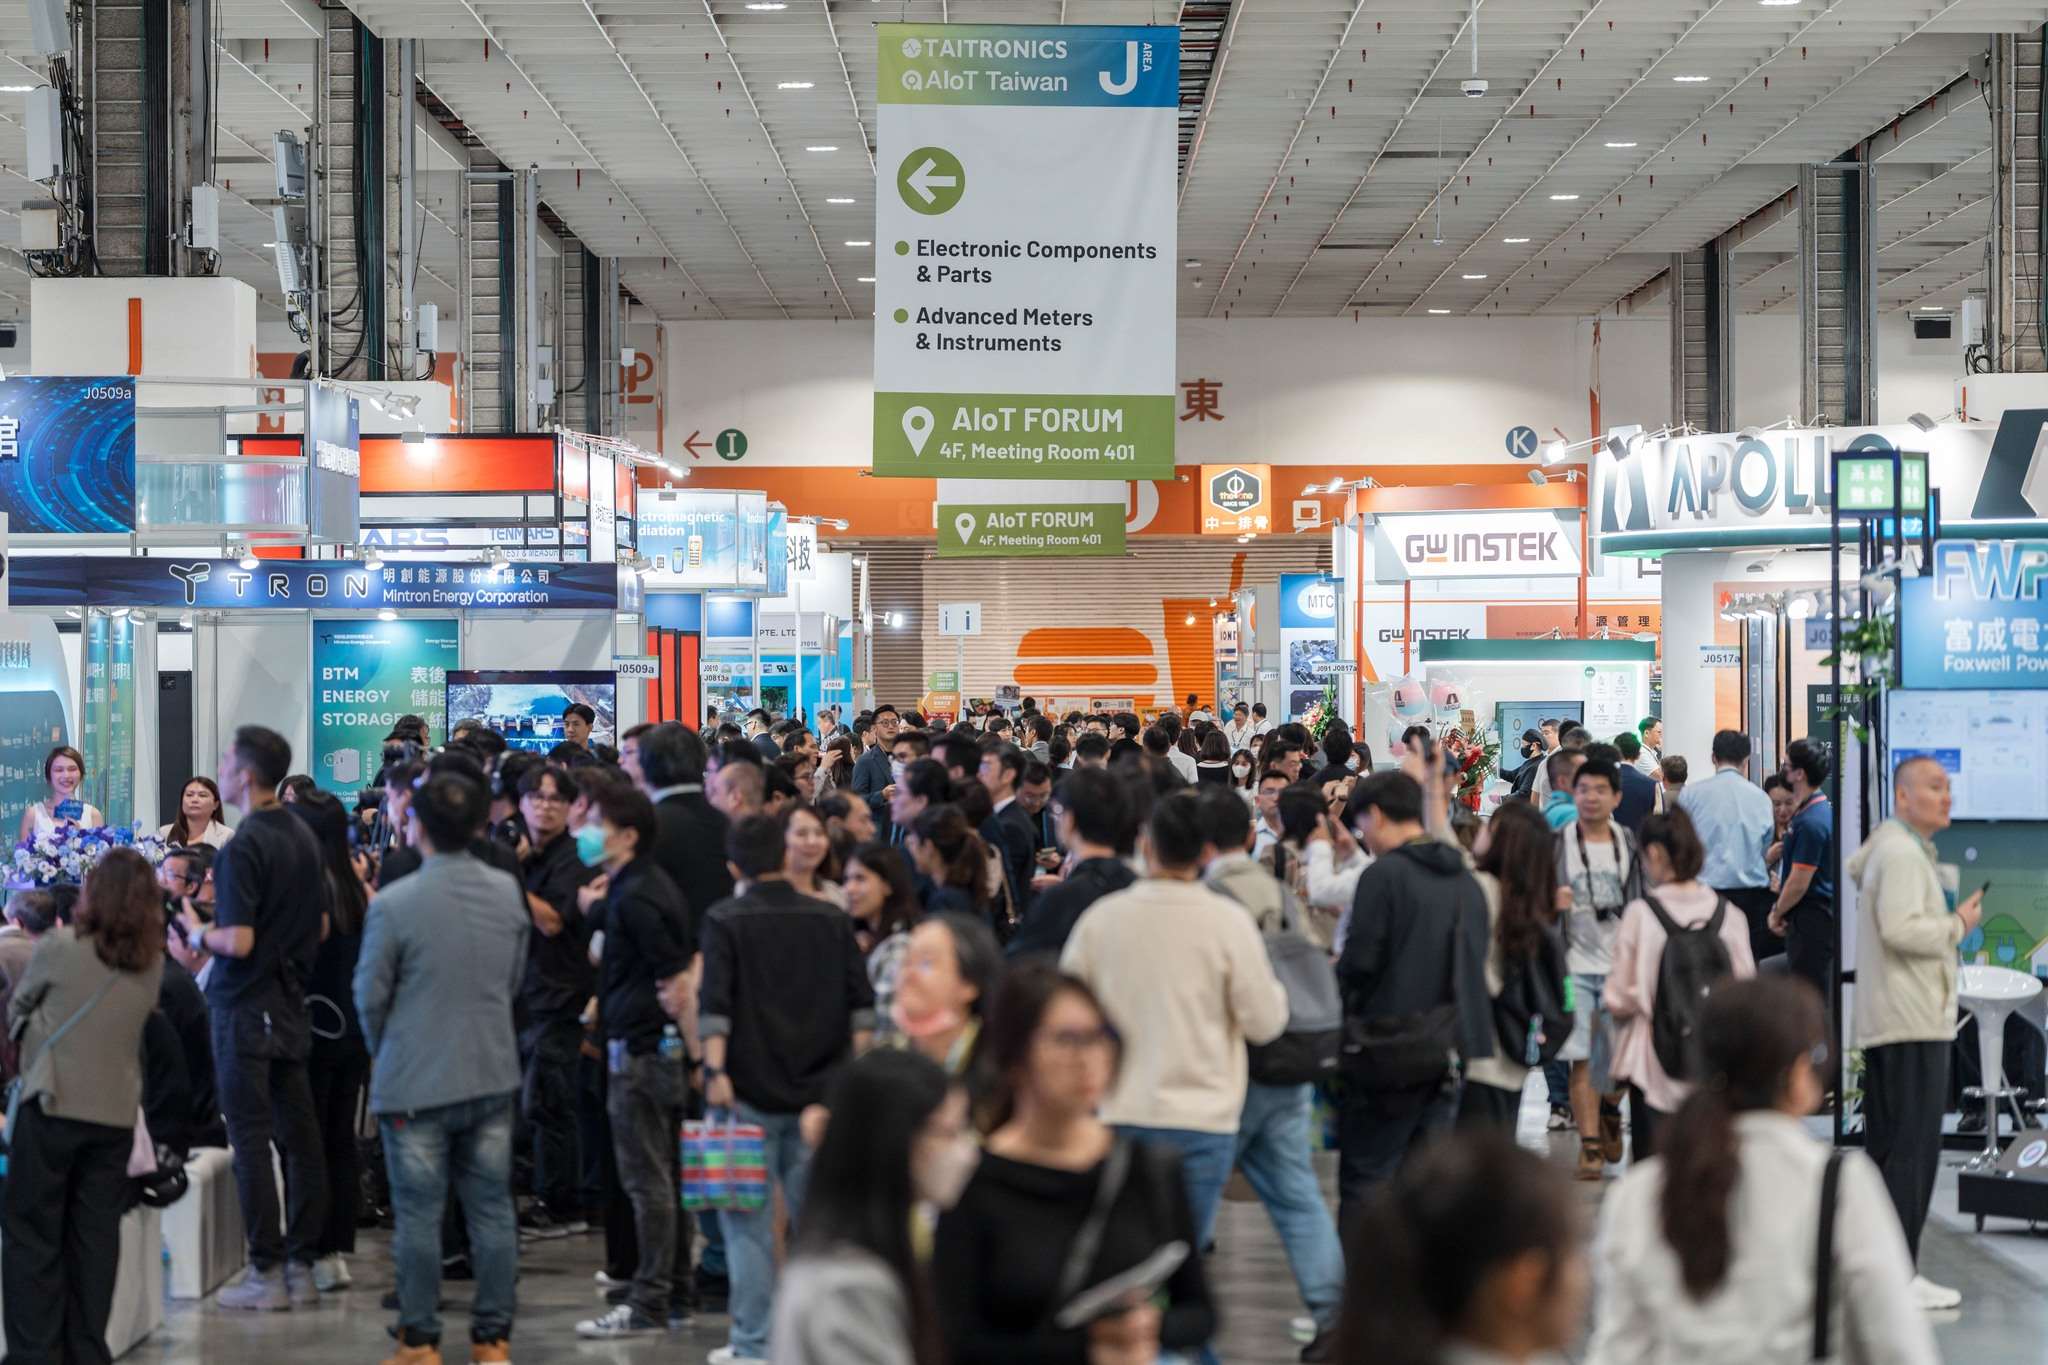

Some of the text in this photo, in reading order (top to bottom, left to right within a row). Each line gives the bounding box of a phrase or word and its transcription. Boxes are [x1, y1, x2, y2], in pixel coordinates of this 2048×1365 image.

[924, 39, 1068, 60] TAITRONICS
[1142, 42, 1153, 72] AREA
[1098, 40, 1138, 95] J
[926, 70, 1068, 92] AIoT Taiwan
[917, 239, 1157, 262] Electronic Components
[916, 265, 993, 283] & Parts
[916, 307, 1093, 327] Advanced Meters
[915, 333, 1062, 351] & Instruments
[83, 386, 132, 401] J0509a
[1179, 377, 1226, 423] 東
[952, 407, 1124, 433] AIoT FORUM
[939, 443, 1136, 464] 4F, Meeting Room 401
[1668, 434, 1895, 514] APOLL
[637, 511, 725, 527] ctromagnetic
[986, 512, 1094, 528] AIoT FORUM
[622, 524, 685, 537] Rdiation
[979, 533, 1102, 548] 4F, Meeting Room 401
[383, 589, 549, 606] Mintron Energy Corporation
[1943, 616, 2048, 653] 富威電
[617, 664, 655, 675] J0509a
[1943, 654, 2010, 673] Foxwell
[322, 667, 359, 681] BTM
[410, 666, 446, 685] 表後
[322, 690, 390, 704] ENERGY
